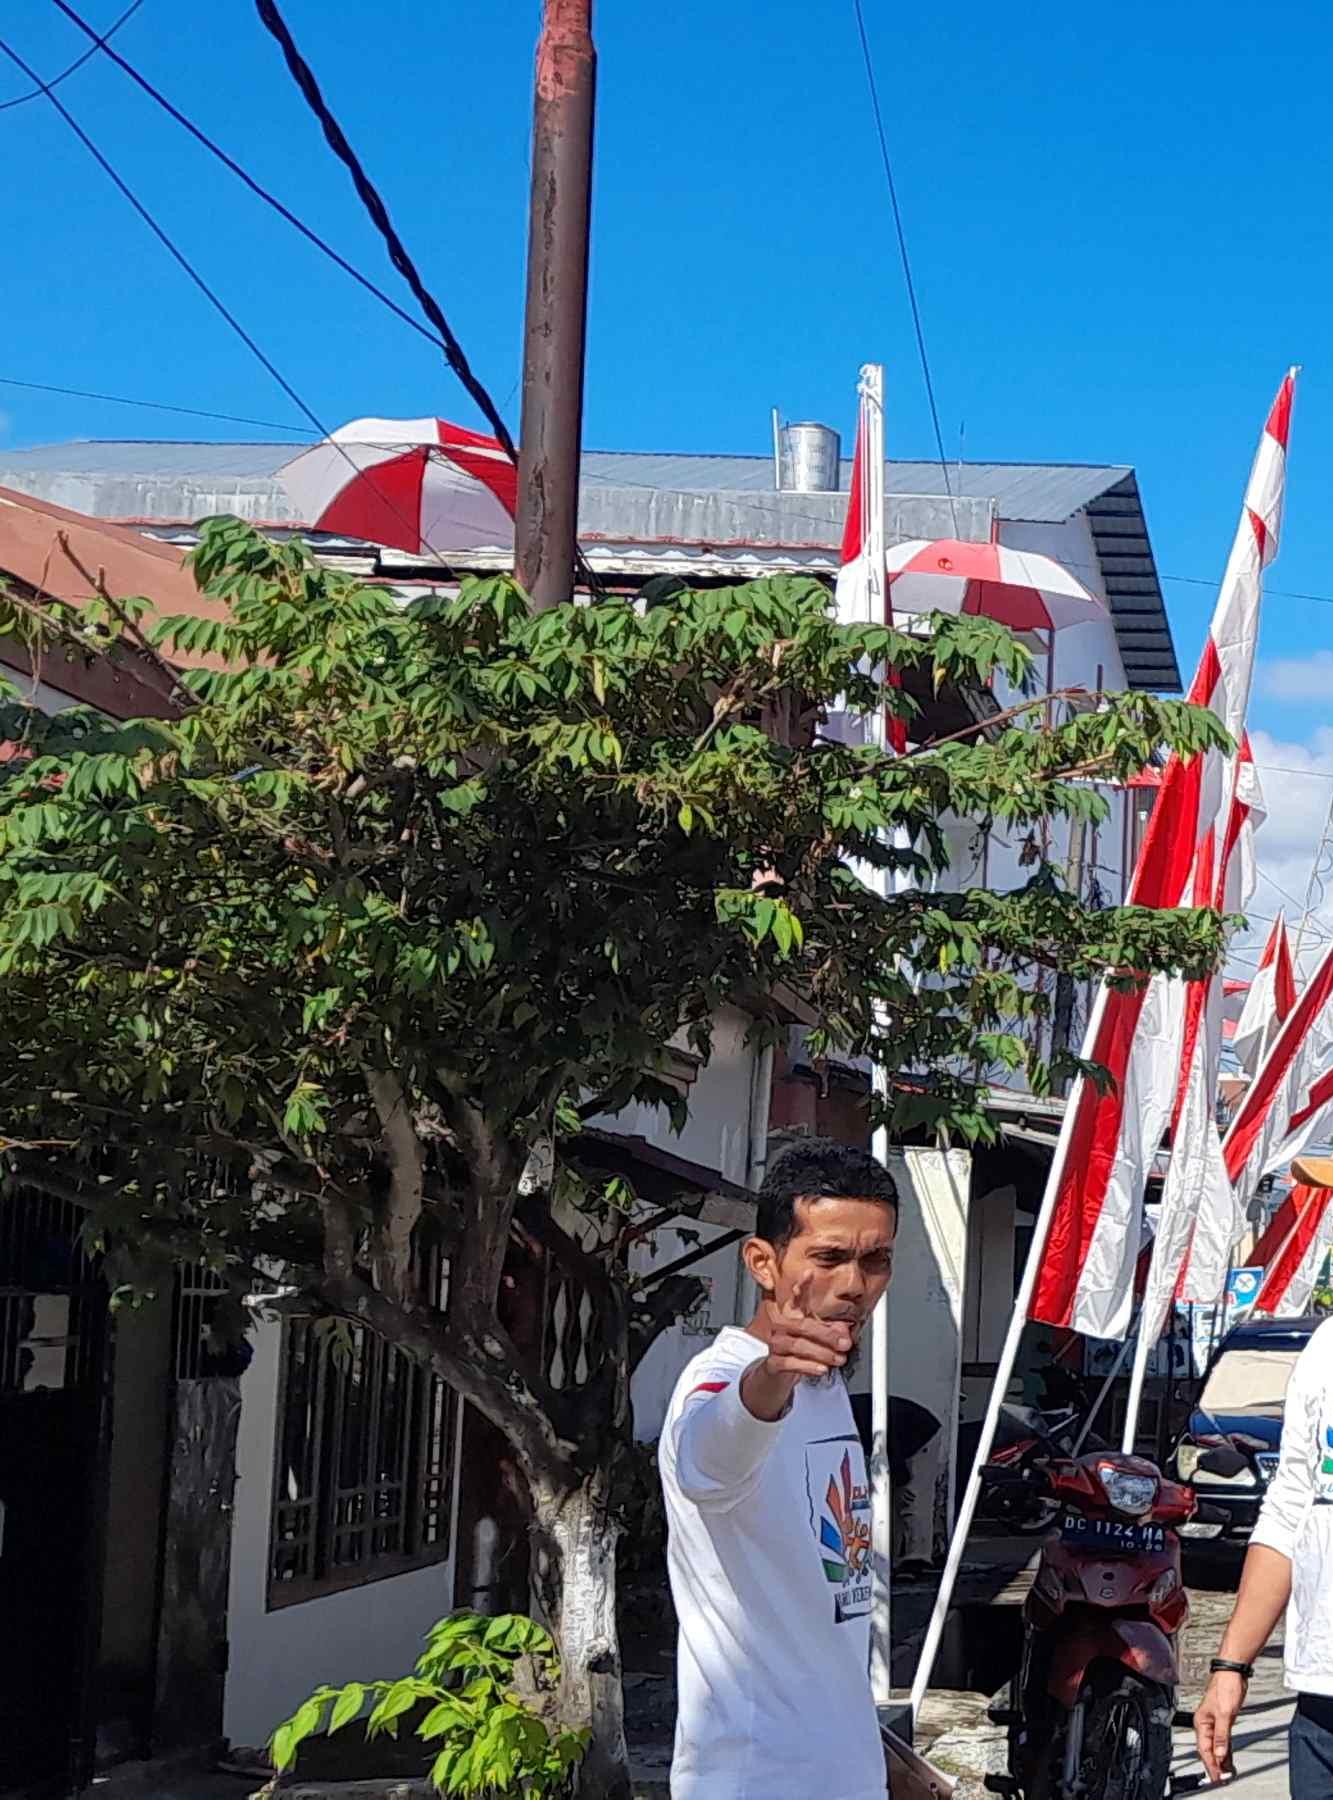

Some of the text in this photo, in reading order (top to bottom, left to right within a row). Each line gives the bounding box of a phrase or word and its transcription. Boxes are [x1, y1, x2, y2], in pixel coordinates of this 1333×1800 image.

[1065, 1516, 1164, 1541] DC 1124 HA
